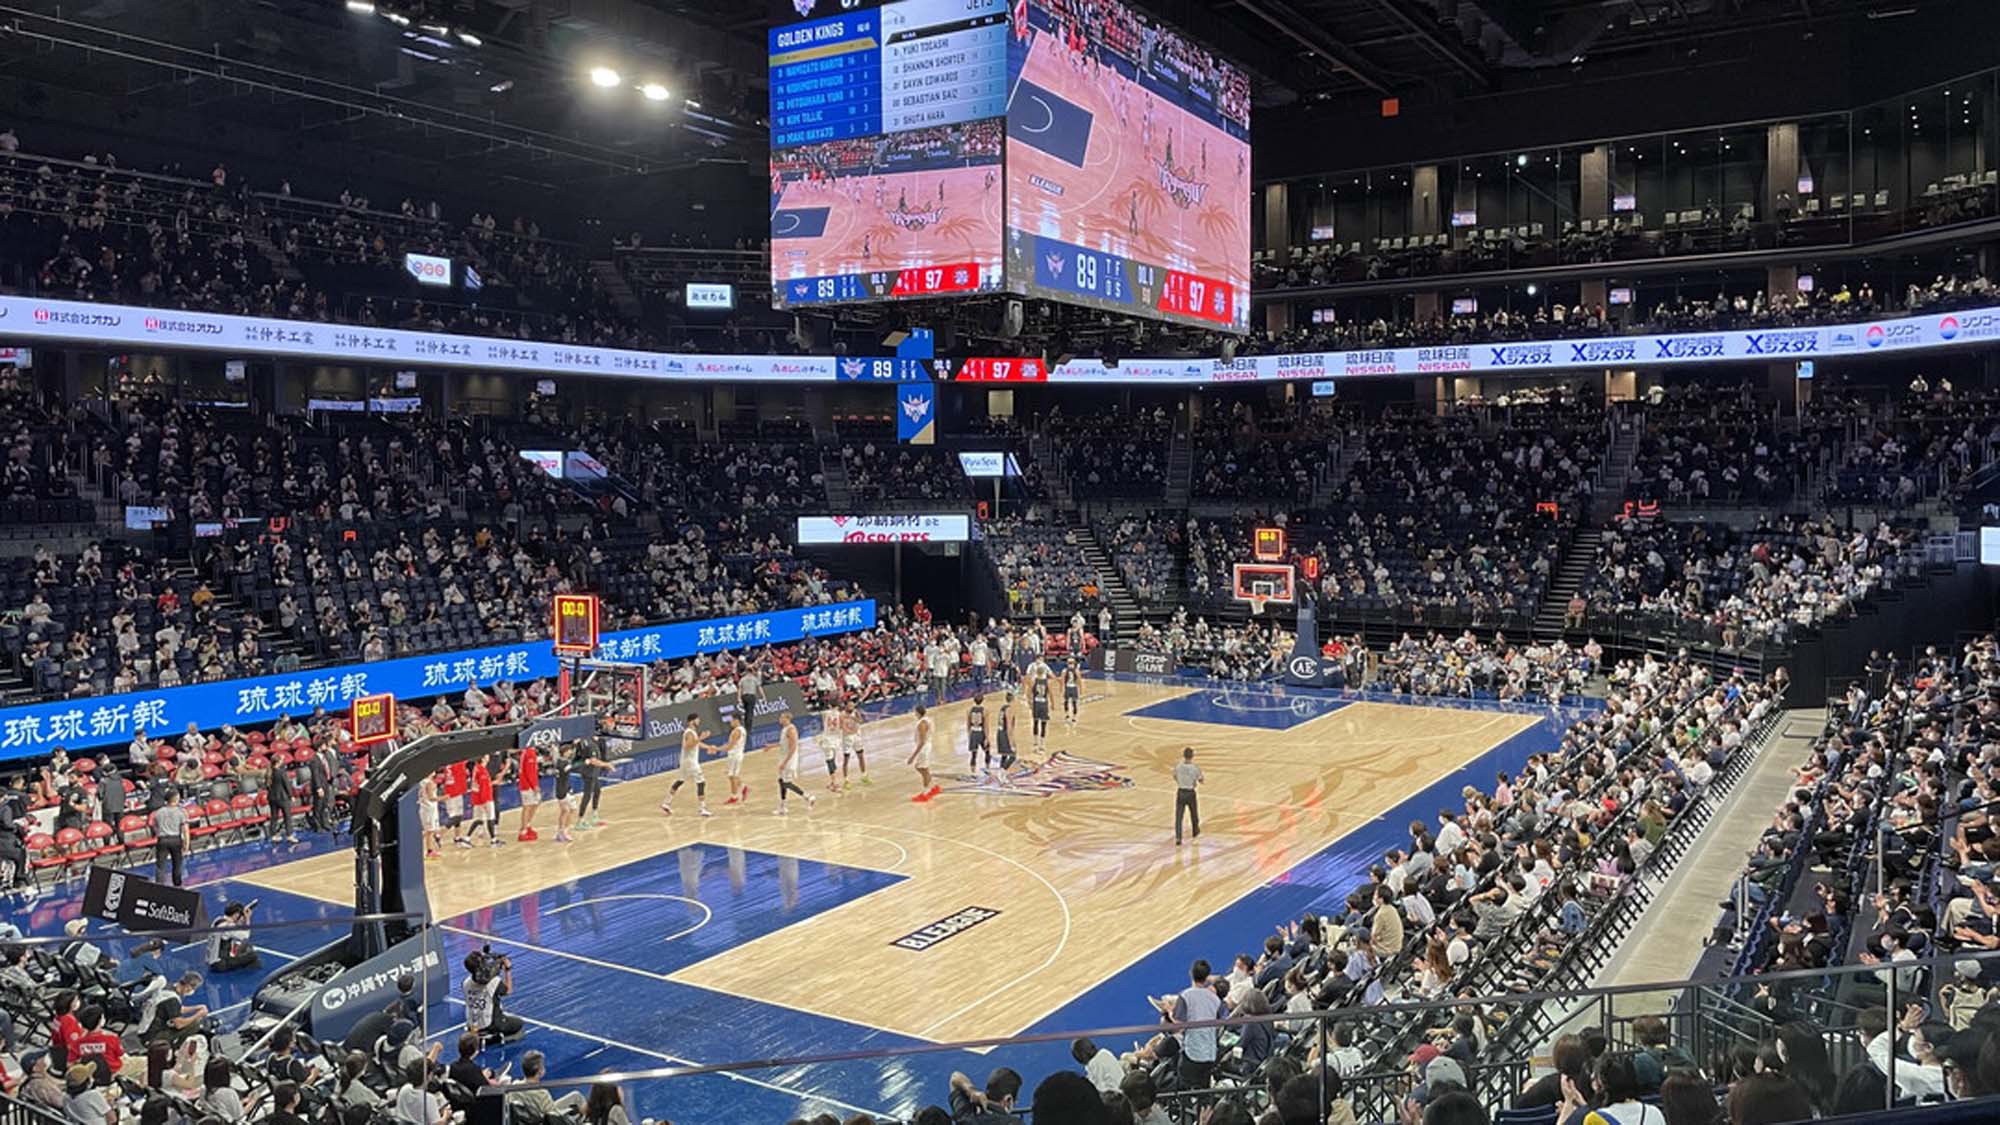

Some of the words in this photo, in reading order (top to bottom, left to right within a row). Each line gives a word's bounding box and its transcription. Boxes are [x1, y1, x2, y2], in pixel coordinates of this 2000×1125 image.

[778, 28, 814, 47] GOLDEN
[815, 22, 844, 40] KINGS
[903, 60, 934, 73] SHANNON
[936, 53, 965, 67] SHORTER
[903, 78, 923, 90] GAVIN
[925, 71, 959, 86] EDWARDS
[903, 93, 940, 106] SEBASTIAN
[903, 112, 925, 125] SHUTA
[926, 270, 943, 289] 97
[1077, 253, 1097, 290] 89
[817, 279, 834, 297] 89
[1190, 281, 1204, 312] 97
[50, 312, 121, 327] 株式会社オカノ
[159, 320, 223, 334] 株式会社オカノ
[1278, 355, 1325, 368] 琉球日産
[1346, 351, 1395, 365] 琉球日産
[1418, 347, 1469, 361] 琉球日産
[873, 360, 892, 377] 89
[993, 362, 1010, 378] 97
[1212, 371, 1258, 380] NISSAN
[1277, 368, 1325, 378] NISSAN
[1345, 365, 1396, 375] NISSAN
[1417, 361, 1472, 372] NISSAN
[801, 606, 863, 631] 琉球新報
[698, 618, 771, 646] 琉球新報
[592, 634, 662, 662] 球新報
[422, 650, 531, 687] 琉球新報
[236, 672, 370, 714] 琉球新報
[2, 699, 169, 748] 琉球新報
[148, 902, 190, 925] SoftBank
[346, 951, 439, 998] 沖縄ヤマト運輸
